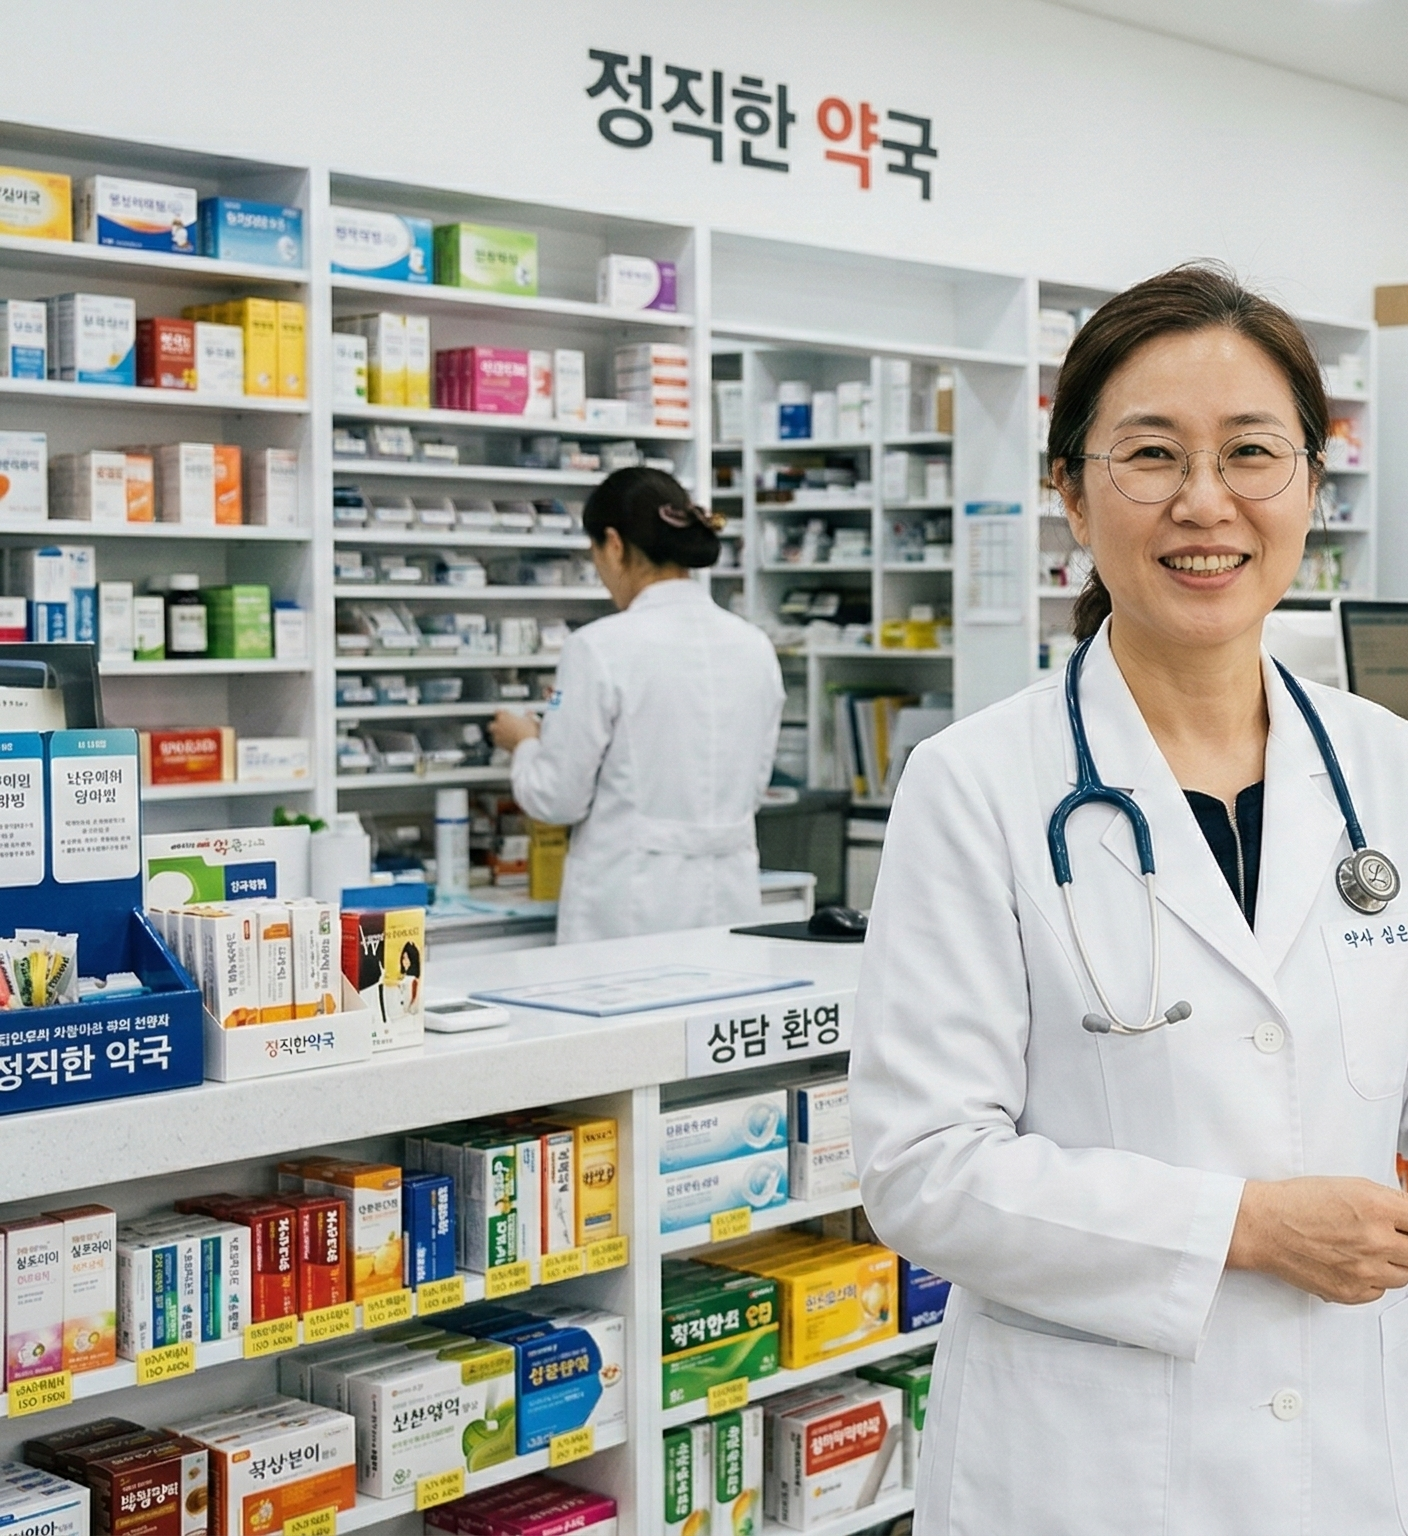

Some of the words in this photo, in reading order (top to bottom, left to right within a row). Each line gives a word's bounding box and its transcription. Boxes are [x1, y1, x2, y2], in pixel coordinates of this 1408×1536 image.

[585, 48, 796, 173] 정직한
[816, 97, 939, 202] 약국
[1344, 927, 1374, 948] 약사
[265, 1031, 335, 1058] 정직한약국
[707, 1013, 770, 1064] 상담
[781, 1003, 840, 1051] 환영
[0, 1043, 96, 1092] 정직한
[105, 1034, 173, 1074] 약국
